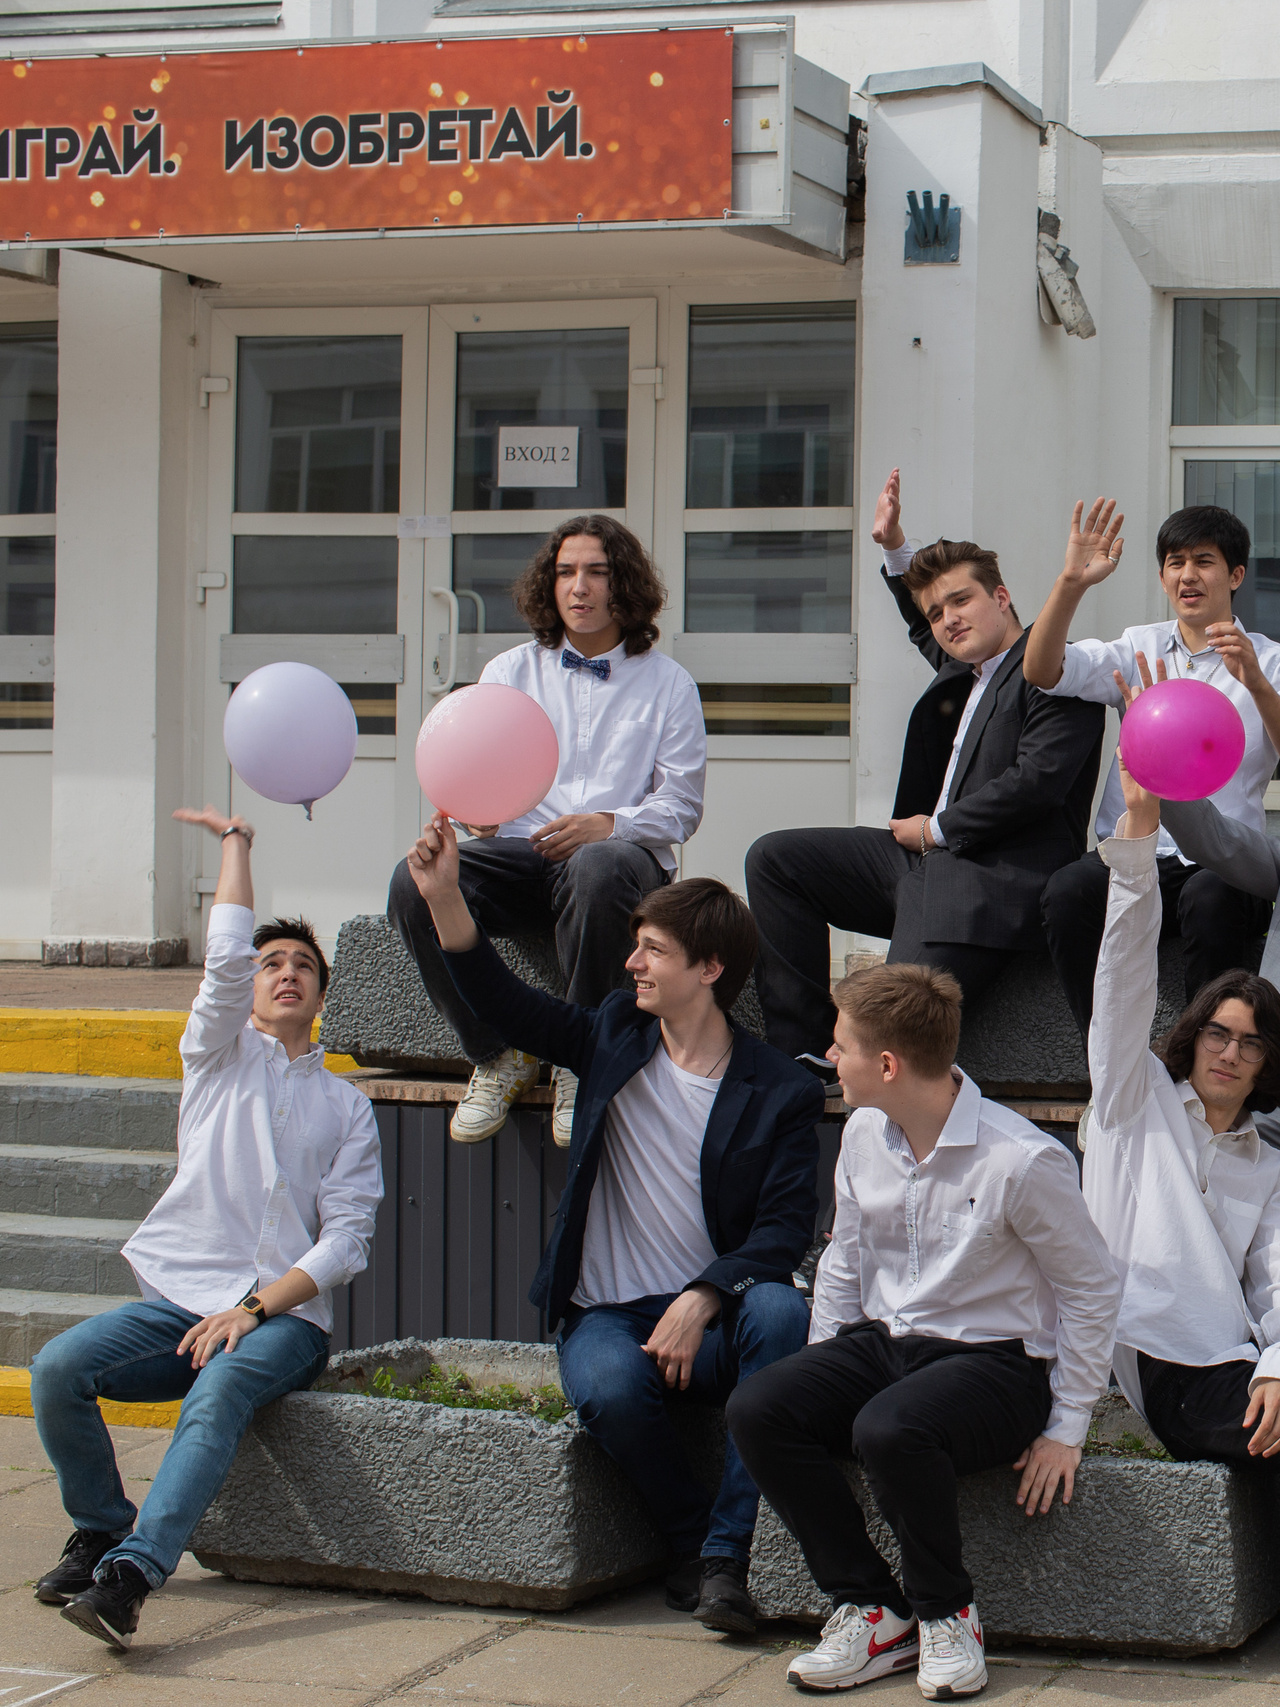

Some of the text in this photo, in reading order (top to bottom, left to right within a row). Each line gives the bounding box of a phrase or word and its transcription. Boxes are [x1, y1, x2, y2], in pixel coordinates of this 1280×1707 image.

[0, 90, 595, 180] ГРАЙ. ИЗОБРЕТАЙ.
[504, 446, 570, 464] ВХОД 2
